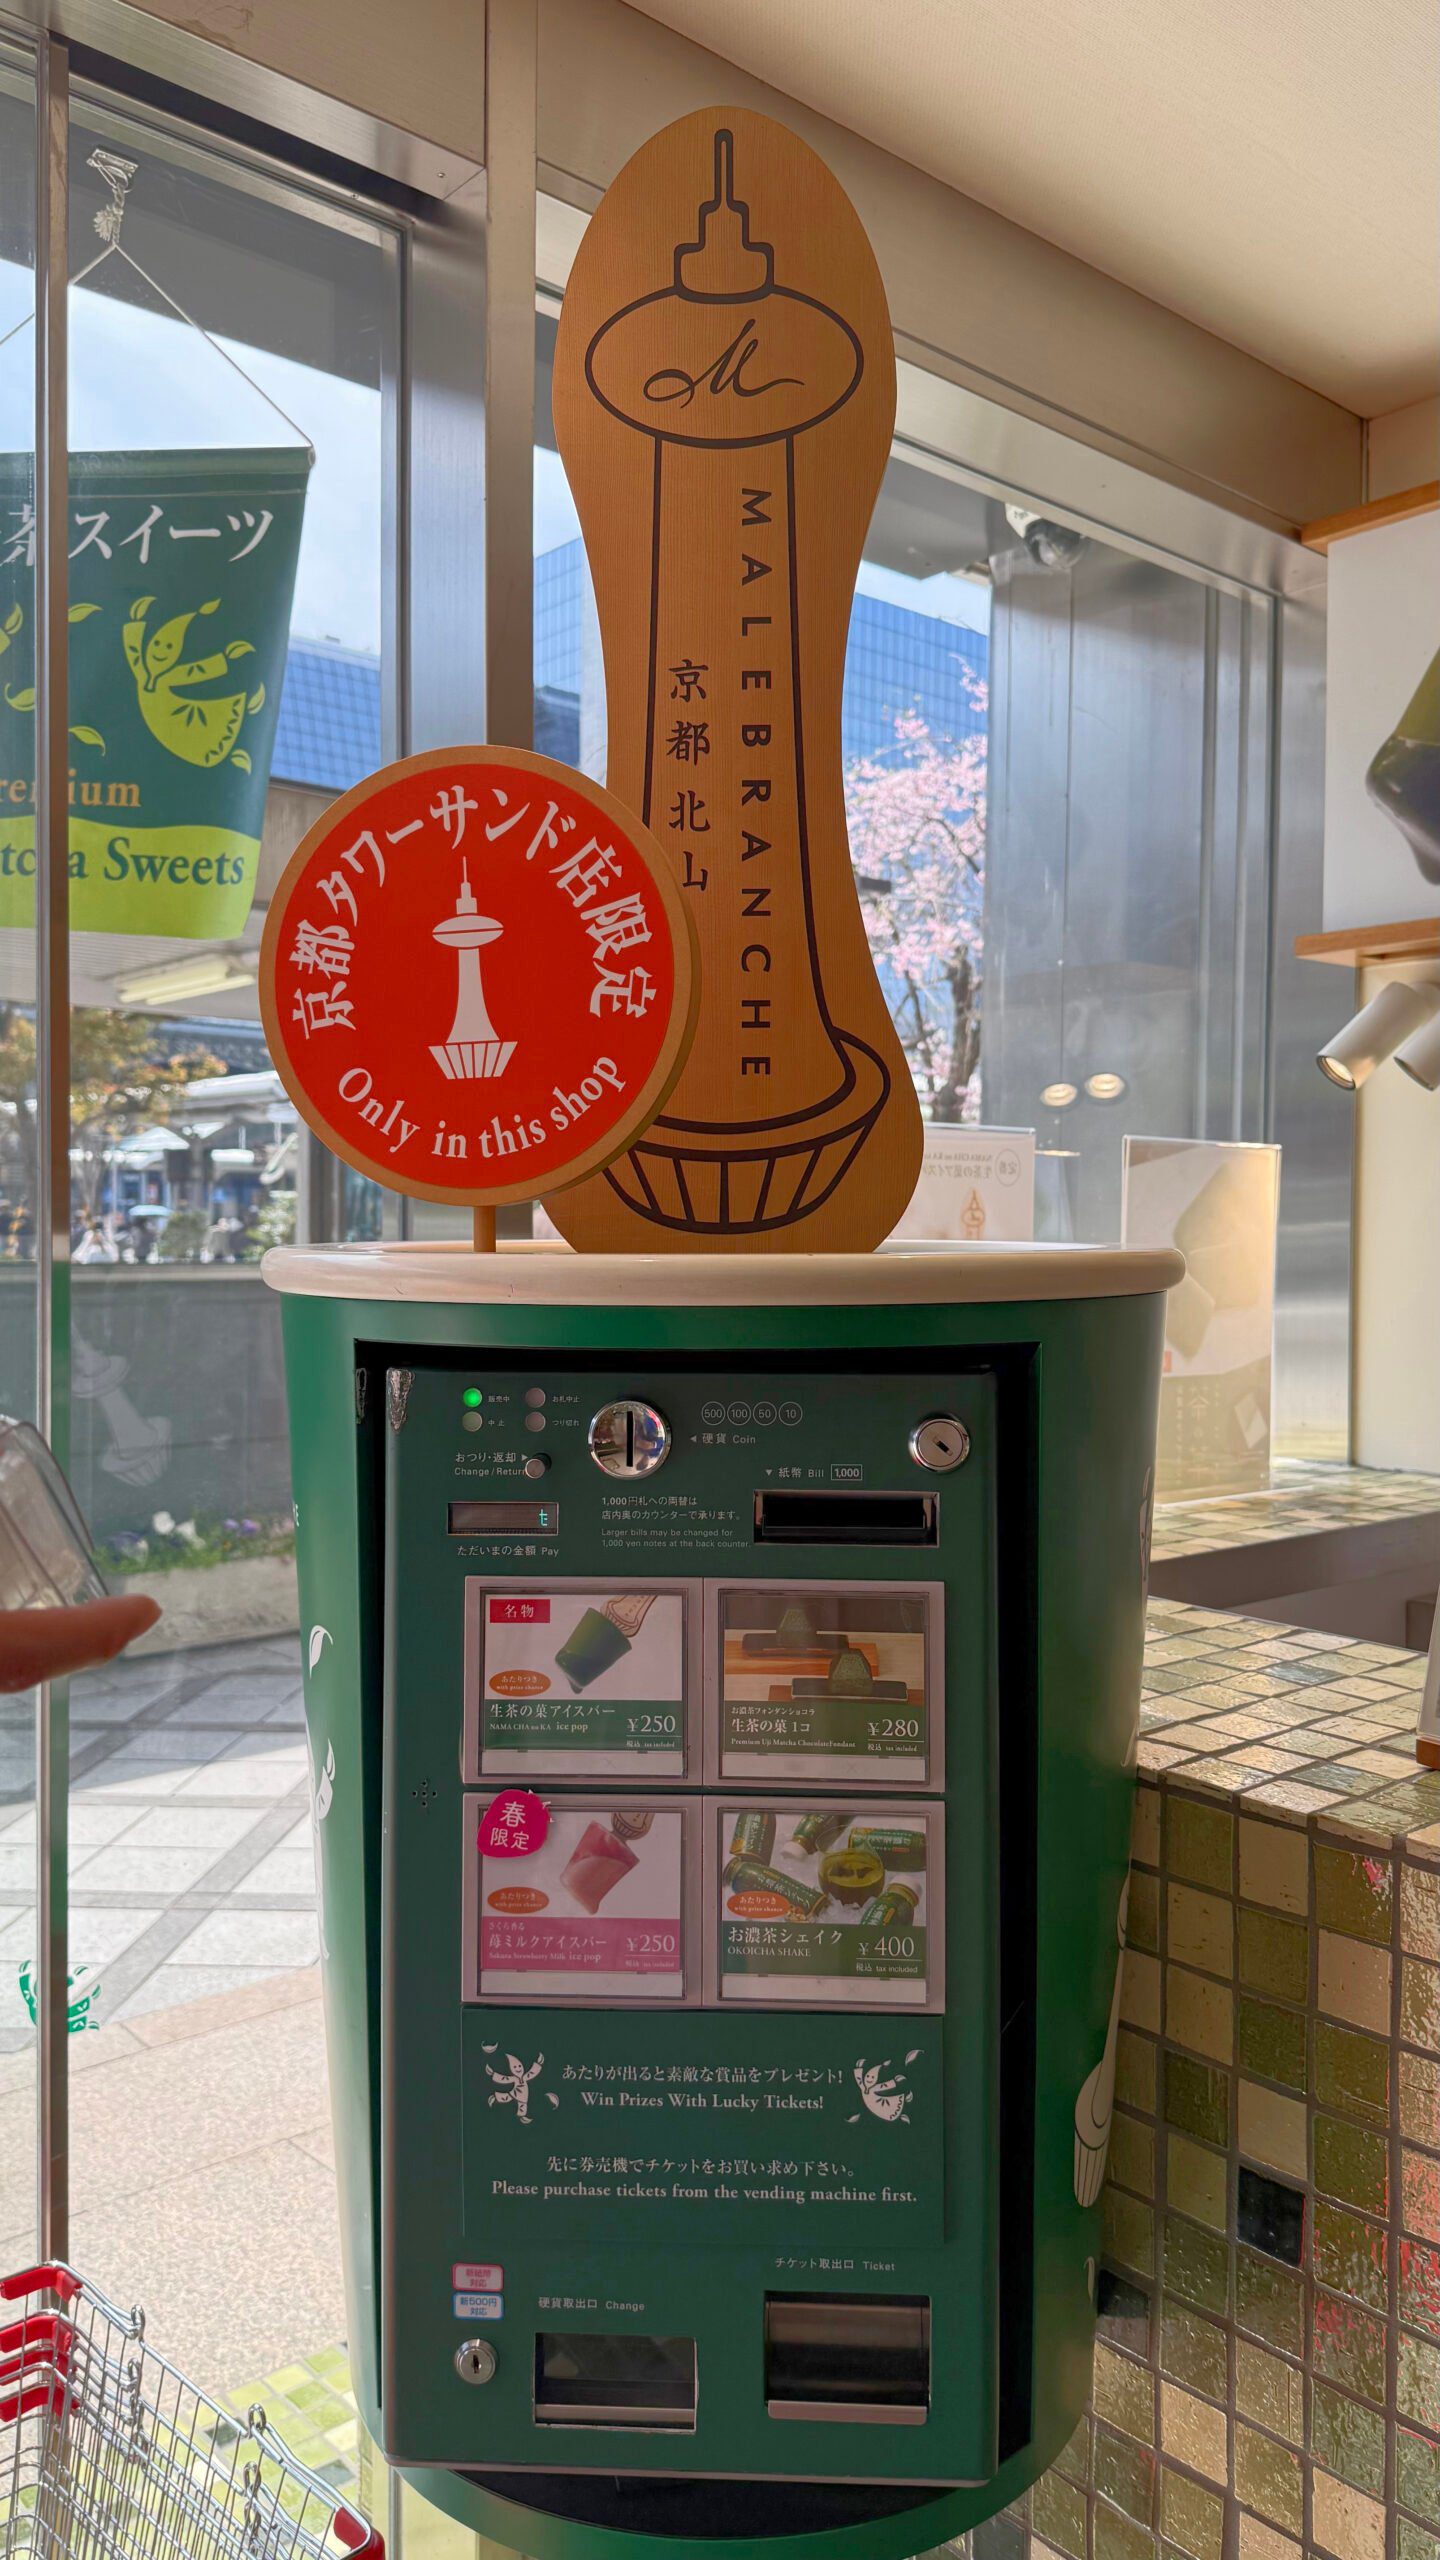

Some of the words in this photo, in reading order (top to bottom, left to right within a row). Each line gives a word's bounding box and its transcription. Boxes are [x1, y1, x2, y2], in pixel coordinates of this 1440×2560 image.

[665, 658, 712, 892] 京都北山
[740, 487, 773, 1076] MALEBRANCHE
[103, 836, 245, 886] Sweets
[288, 784, 657, 1041] 京都タワーサンド店限定
[338, 1067, 421, 1154] Only
[432, 1119, 468, 1159] in
[479, 1114, 547, 1159] this
[550, 1056, 627, 1132] shop
[704, 1408, 723, 1419] 500
[731, 1408, 748, 1419] 100
[758, 1408, 771, 1419] 50
[785, 1409, 797, 1419] 10
[702, 1433, 727, 1445] 硬貨
[732, 1435, 756, 1445] Coin
[778, 1466, 802, 1479] 紙幣
[808, 1469, 824, 1478] Bill
[834, 1468, 860, 1479] 1,000
[601, 1528, 628, 1538] Larger
[631, 1528, 648, 1536] bills
[650, 1530, 668, 1538] may
[670, 1529, 681, 1537] be
[683, 1529, 719, 1538] changed
[721, 1529, 734, 1537] for
[457, 1545, 536, 1556] ただいまの金額
[541, 1547, 559, 1557] Pay
[625, 1541, 641, 1549] yen
[643, 1540, 667, 1548] notes
[669, 1540, 678, 1548] at
[680, 1540, 693, 1548] the
[695, 1540, 715, 1548] back
[503, 1603, 535, 1619] 名物
[489, 1703, 616, 1719] 生茶の菓アイスバー
[556, 1721, 570, 1731] ice
[571, 1723, 588, 1733] pop
[627, 1714, 676, 1733] ¥250
[731, 1718, 787, 1733] 生茶の菓
[867, 1718, 919, 1737] ¥280
[499, 1801, 526, 1828] 春
[490, 1827, 530, 1850] 限定
[489, 1934, 607, 1949] 苺ミルクアイスバー
[728, 1926, 843, 1944] お濃茶シェイク
[626, 1934, 675, 1953] ¥250
[569, 1952, 583, 1961] ice
[584, 1954, 601, 1964] pop
[727, 1945, 776, 1956] OKOICHA
[777, 1948, 811, 1958] SHAKE
[889, 1964, 918, 1974] included
[581, 2091, 614, 2106] Win
[619, 2092, 664, 2107] Prizes
[668, 2092, 707, 2108] With
[712, 2094, 759, 2112] Lucky
[763, 2094, 824, 2109] Tickets!
[491, 2180, 538, 2195] Please
[543, 2181, 611, 2199] purchase
[616, 2183, 667, 2197] tickets
[672, 2183, 708, 2198] from
[714, 2184, 738, 2199] the
[744, 2186, 805, 2204] vending
[810, 2187, 876, 2201] machine
[882, 2187, 917, 2202] first.
[774, 2257, 854, 2270] チケット取出口
[862, 2261, 895, 2271] Ticket
[538, 2296, 598, 2309] 硬貨取出口
[605, 2300, 645, 2312] Change
